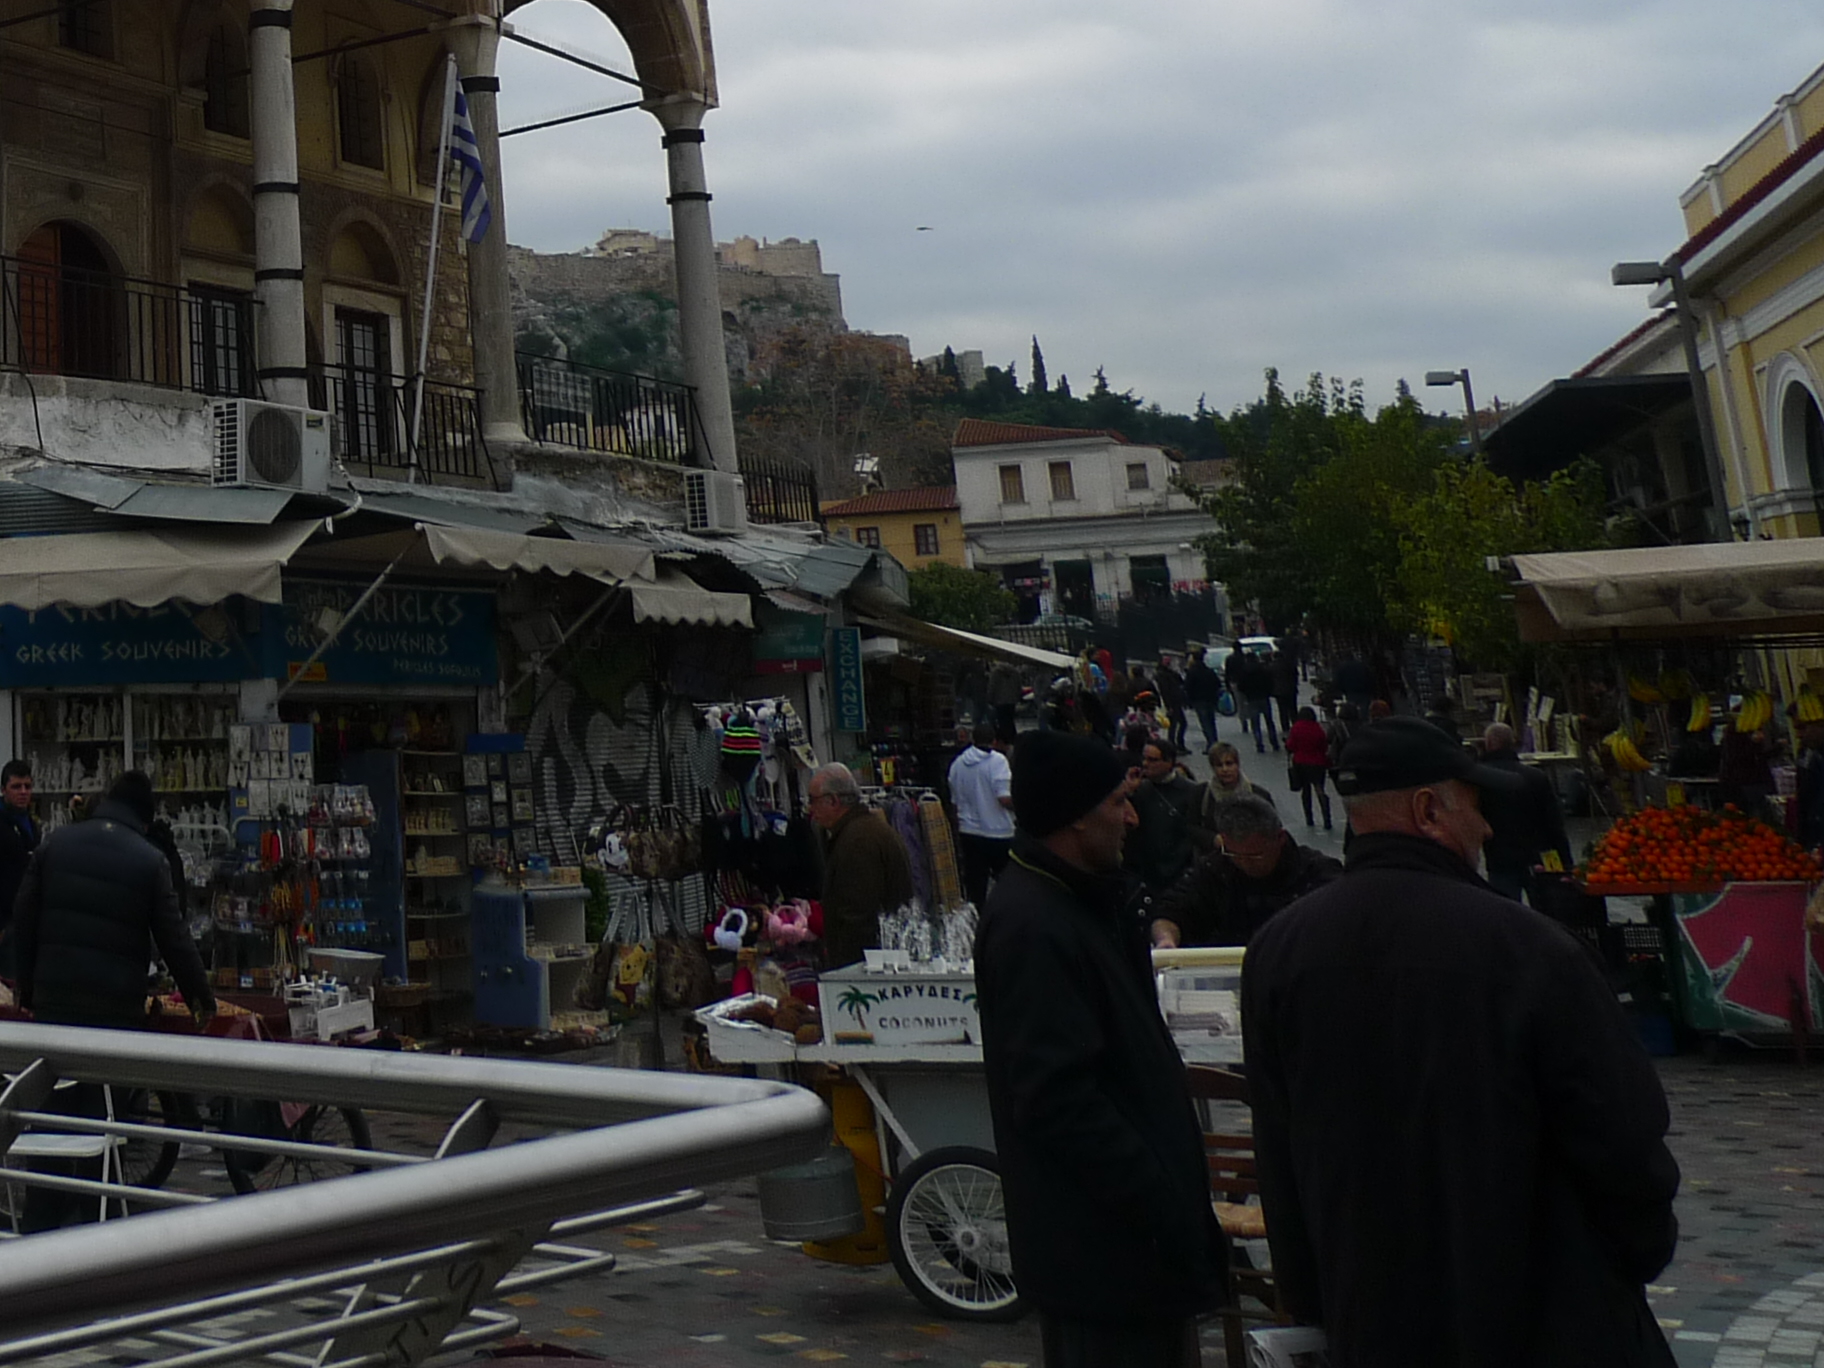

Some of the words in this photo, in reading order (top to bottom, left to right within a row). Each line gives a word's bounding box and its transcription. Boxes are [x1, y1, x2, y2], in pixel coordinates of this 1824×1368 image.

[16, 641, 84, 664] GREEK
[100, 638, 231, 661] SOUVENIRS
[353, 629, 449, 656] SOUVENIRS
[838, 630, 860, 729] EXCHANGE
[878, 984, 962, 1001] ΚΑΡΥΔΕΣ
[879, 1016, 968, 1029] COCONUTS
